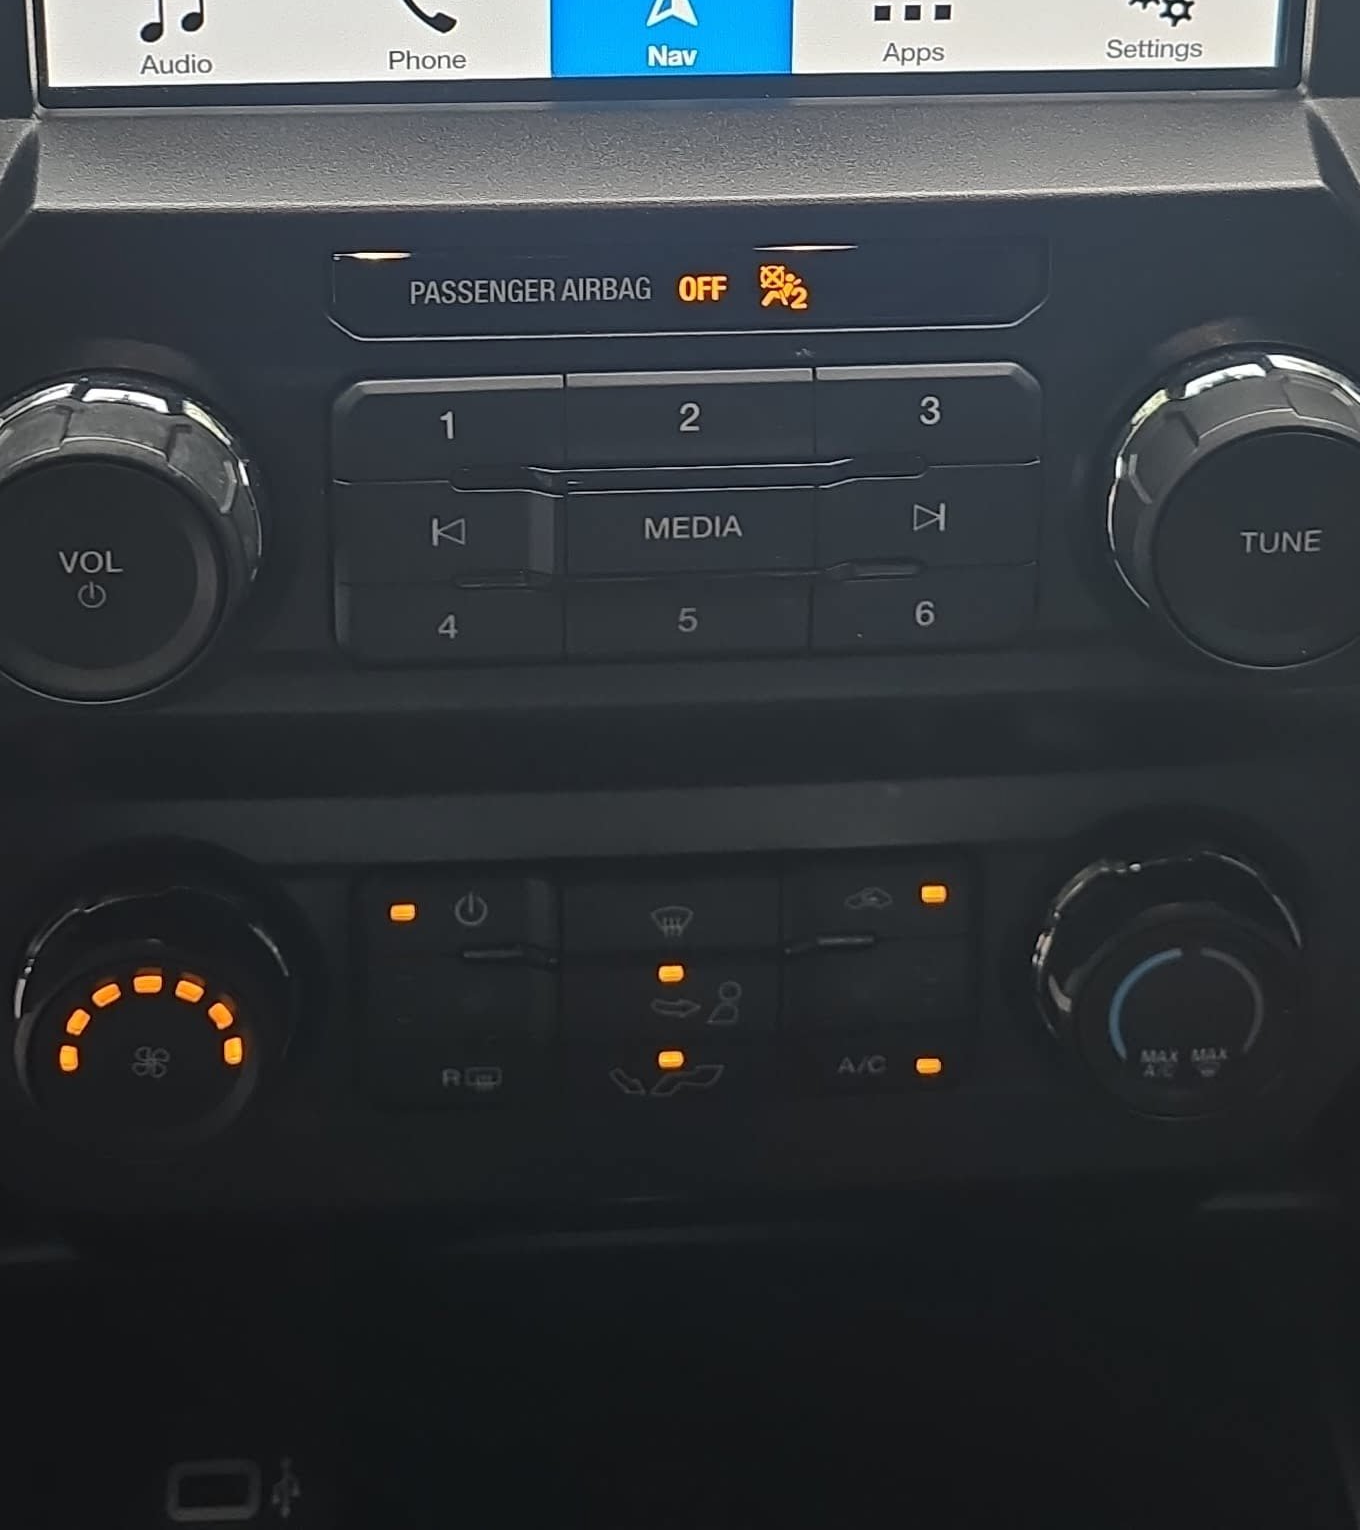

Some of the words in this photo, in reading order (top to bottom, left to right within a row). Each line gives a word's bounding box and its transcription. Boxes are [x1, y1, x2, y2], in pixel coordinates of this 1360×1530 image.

[388, 50, 467, 71] Phone
[647, 44, 698, 67] Nav
[883, 42, 946, 64] Apps
[1106, 38, 1203, 61] Settings
[140, 54, 213, 75] Audio
[410, 278, 556, 304] PASSENGER
[560, 276, 652, 302] AIRBAG
[678, 274, 728, 303] OFF
[678, 402, 701, 432] 2
[919, 395, 941, 424] 3
[439, 411, 456, 439] 1
[643, 514, 742, 541] MEDIA
[1240, 529, 1323, 554] TUNE
[58, 550, 124, 574] VOL
[677, 606, 698, 632] 5
[914, 599, 935, 626] 6
[436, 613, 458, 639] 4
[837, 1054, 887, 1076] A/C
[442, 1069, 461, 1088] R
